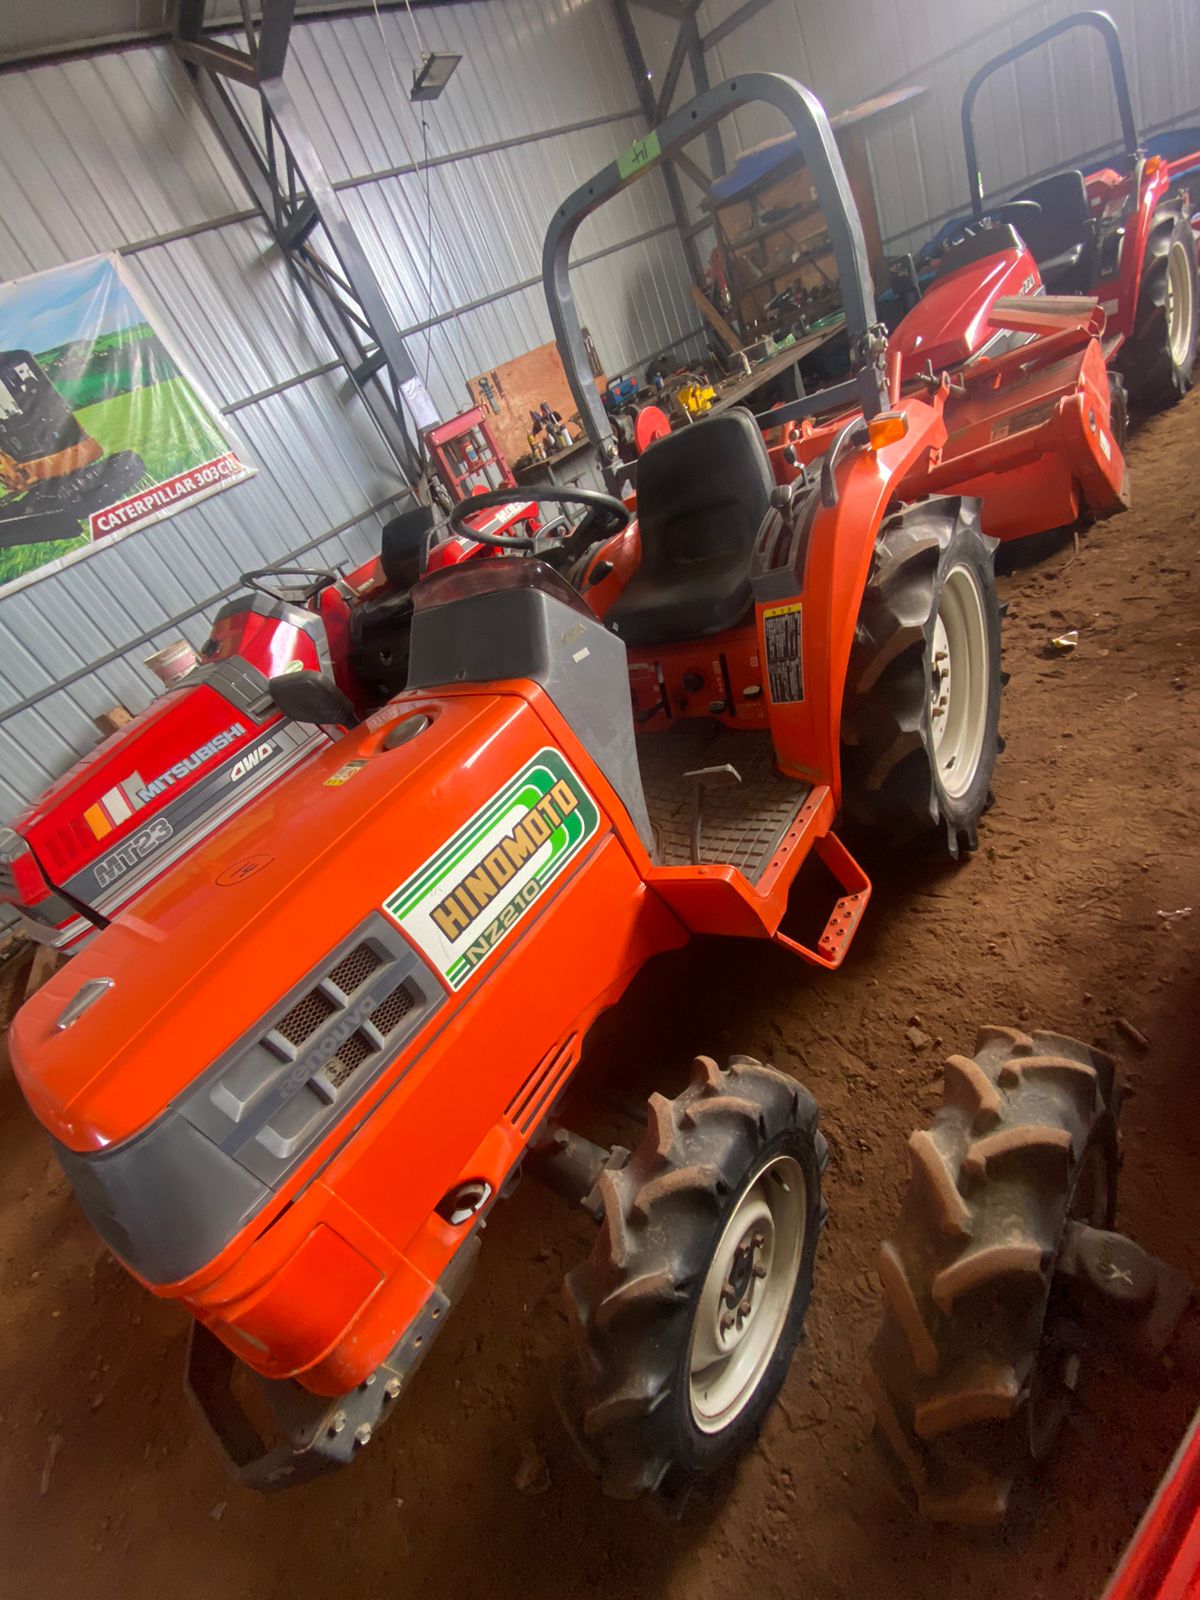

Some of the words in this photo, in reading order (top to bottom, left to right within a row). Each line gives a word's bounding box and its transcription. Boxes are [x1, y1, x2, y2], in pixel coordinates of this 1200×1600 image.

[97, 477, 197, 531] CATERPILLAR
[138, 722, 246, 803] MITSUBISHI
[230, 742, 273, 782] 4WD
[93, 817, 173, 888] MT23
[429, 778, 580, 944] HINOMOTO
[464, 878, 541, 967] NZ210
